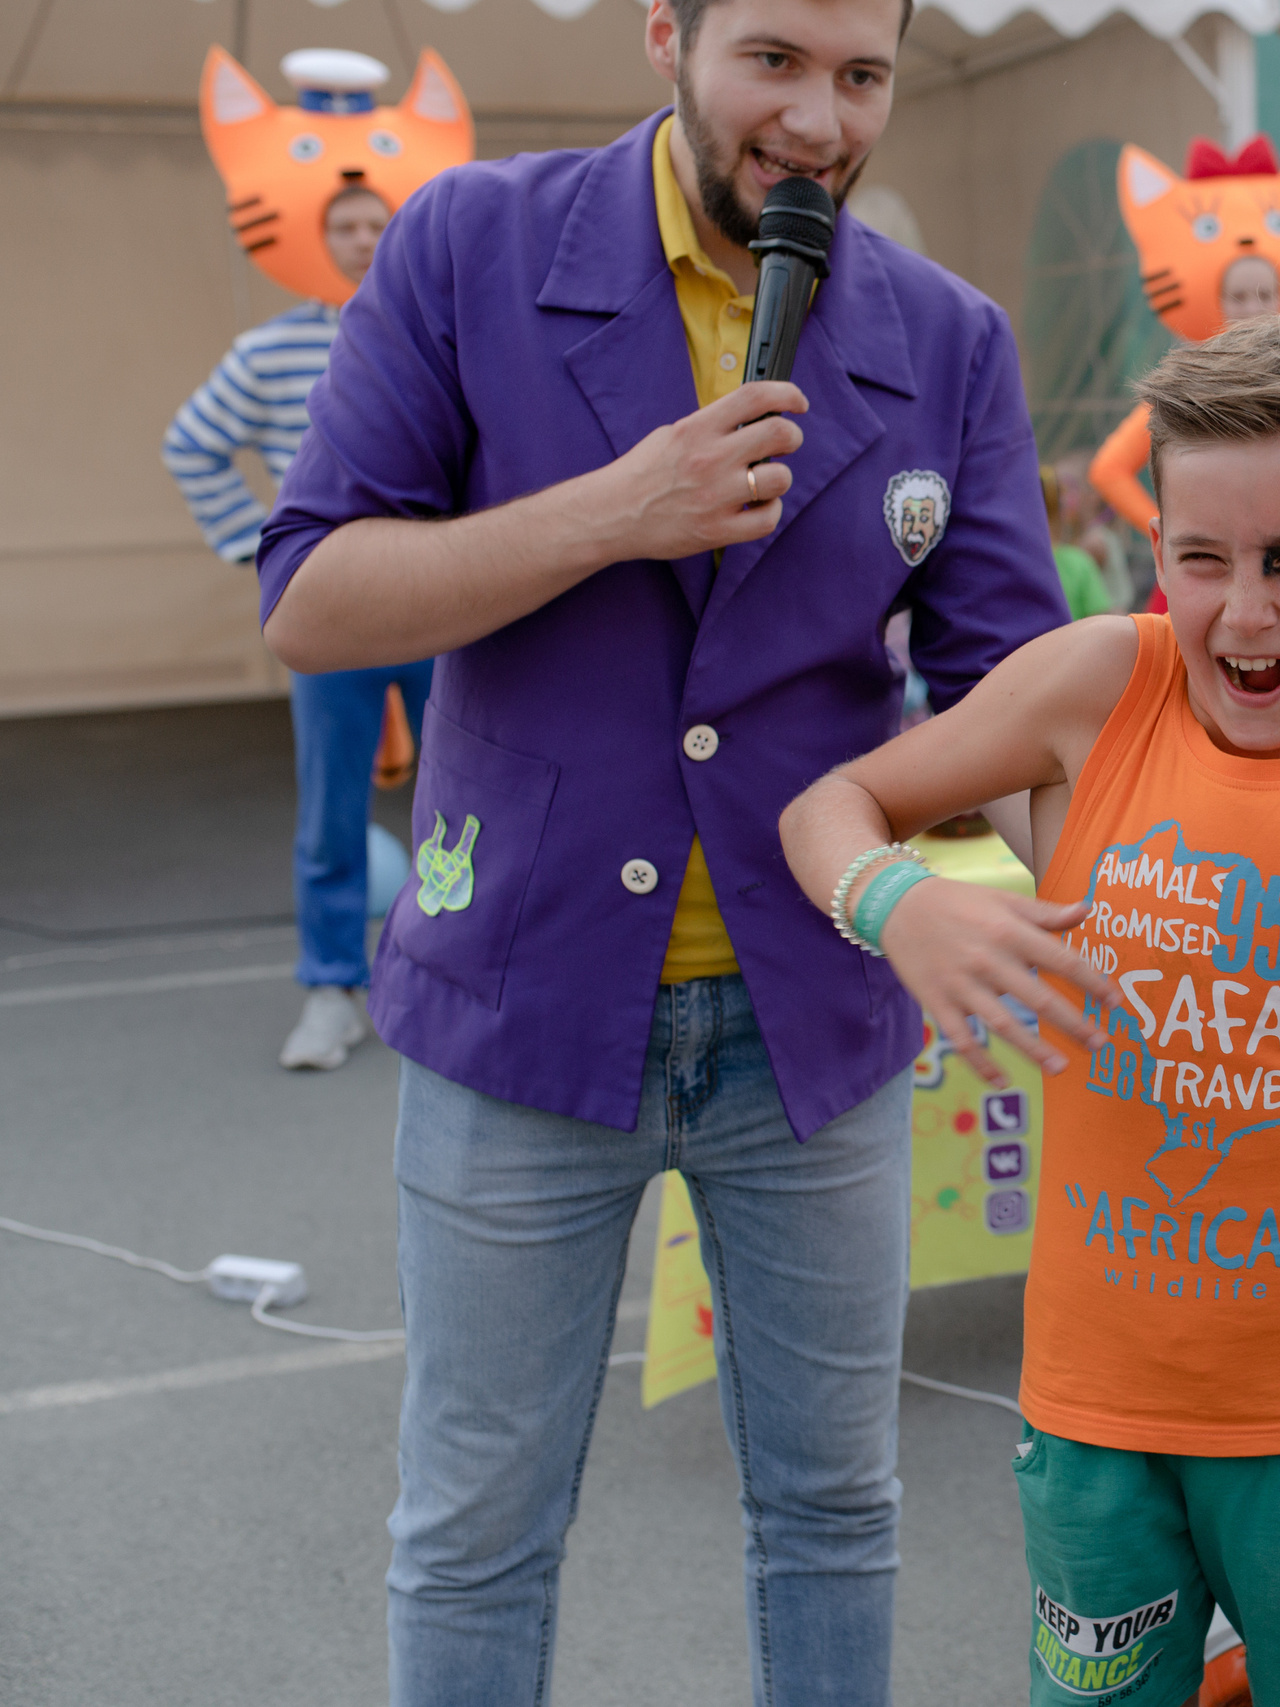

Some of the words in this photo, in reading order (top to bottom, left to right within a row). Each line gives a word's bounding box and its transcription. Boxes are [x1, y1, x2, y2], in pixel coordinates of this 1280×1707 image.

[1097, 853, 1230, 910] ANIMALS
[1080, 900, 1221, 957] PROMISED
[1104, 1266, 1268, 1300] wildlife
[1038, 1588, 1080, 1643] KEEP
[1092, 1599, 1173, 1653] YOUR
[1036, 1623, 1144, 1690] DISTANCE
